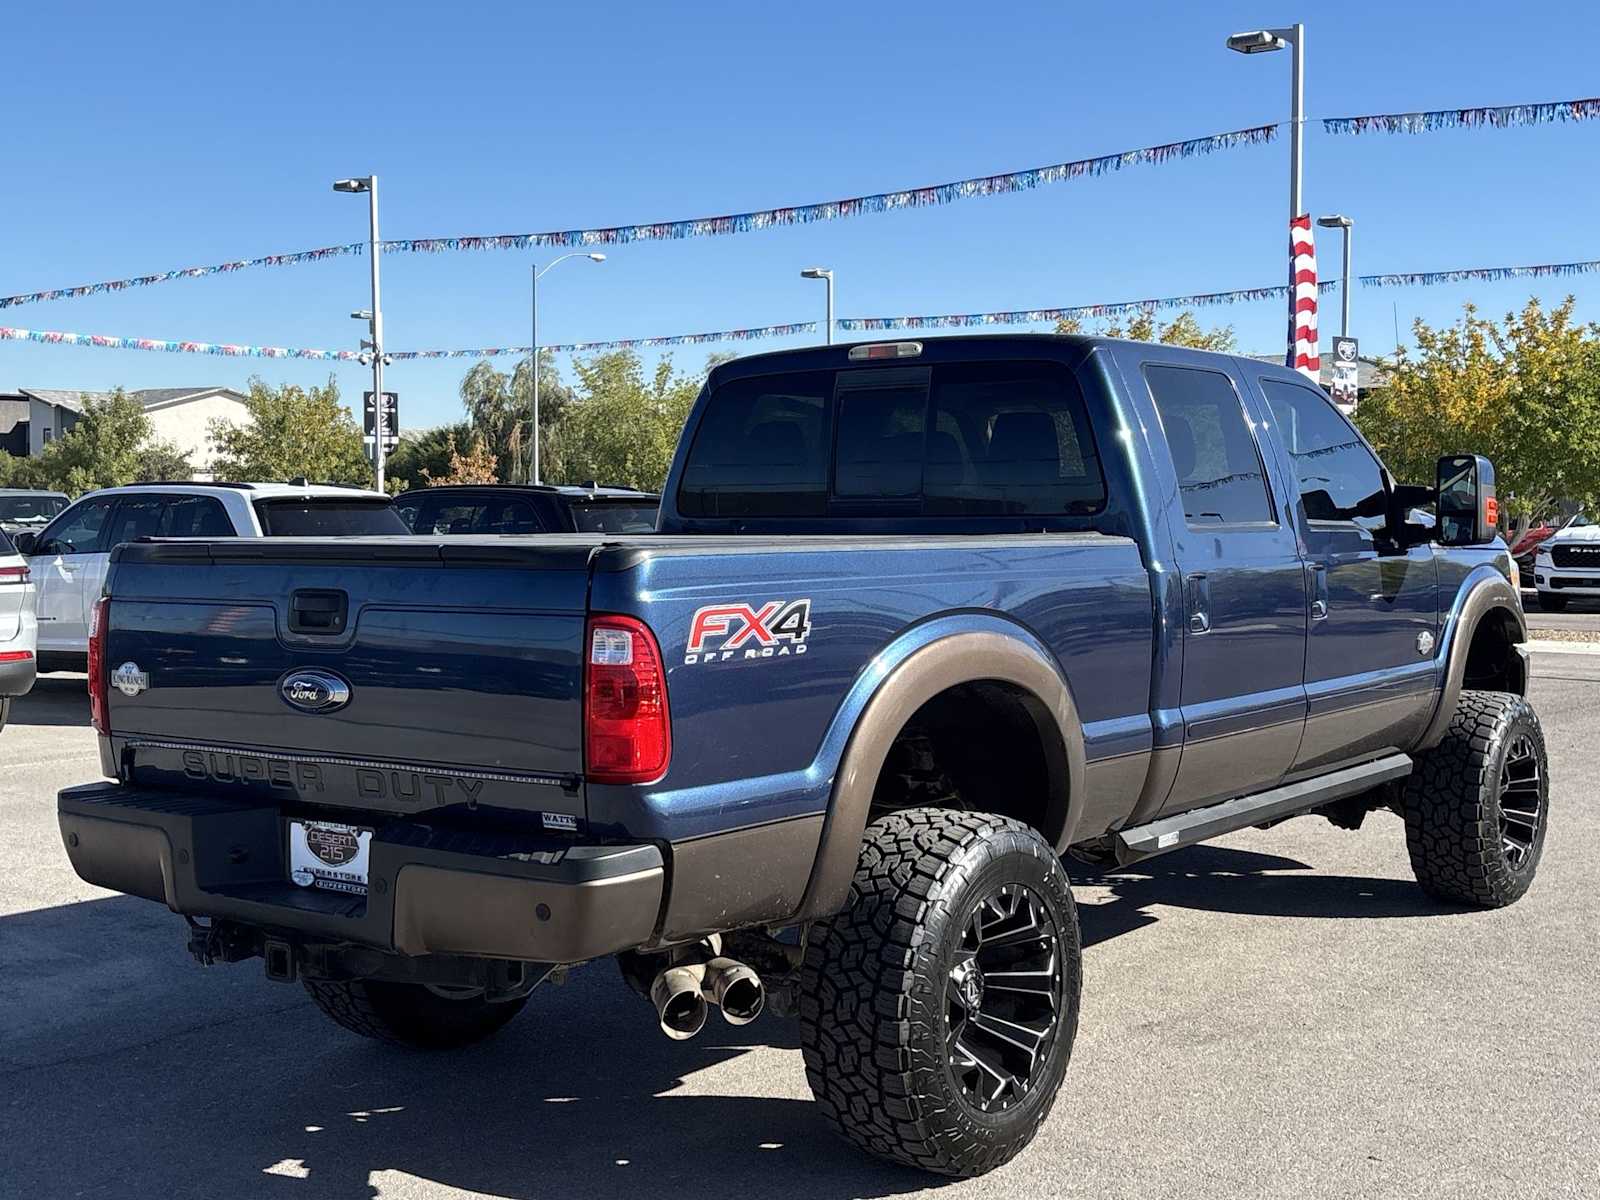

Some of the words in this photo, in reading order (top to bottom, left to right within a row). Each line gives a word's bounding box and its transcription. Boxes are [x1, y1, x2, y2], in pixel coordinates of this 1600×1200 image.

[686, 599, 811, 653] FX4
[685, 651, 734, 664] OFF
[745, 644, 807, 659] ROAD
[290, 681, 319, 700] Ford
[182, 751, 325, 792] SUPER
[356, 768, 484, 809] DUTY
[543, 813, 577, 824] WATTS
[310, 831, 354, 846] DESERT
[319, 845, 344, 860] 215
[303, 867, 363, 882] SUPERSTORE
[318, 880, 367, 895] SUPERSTORE
